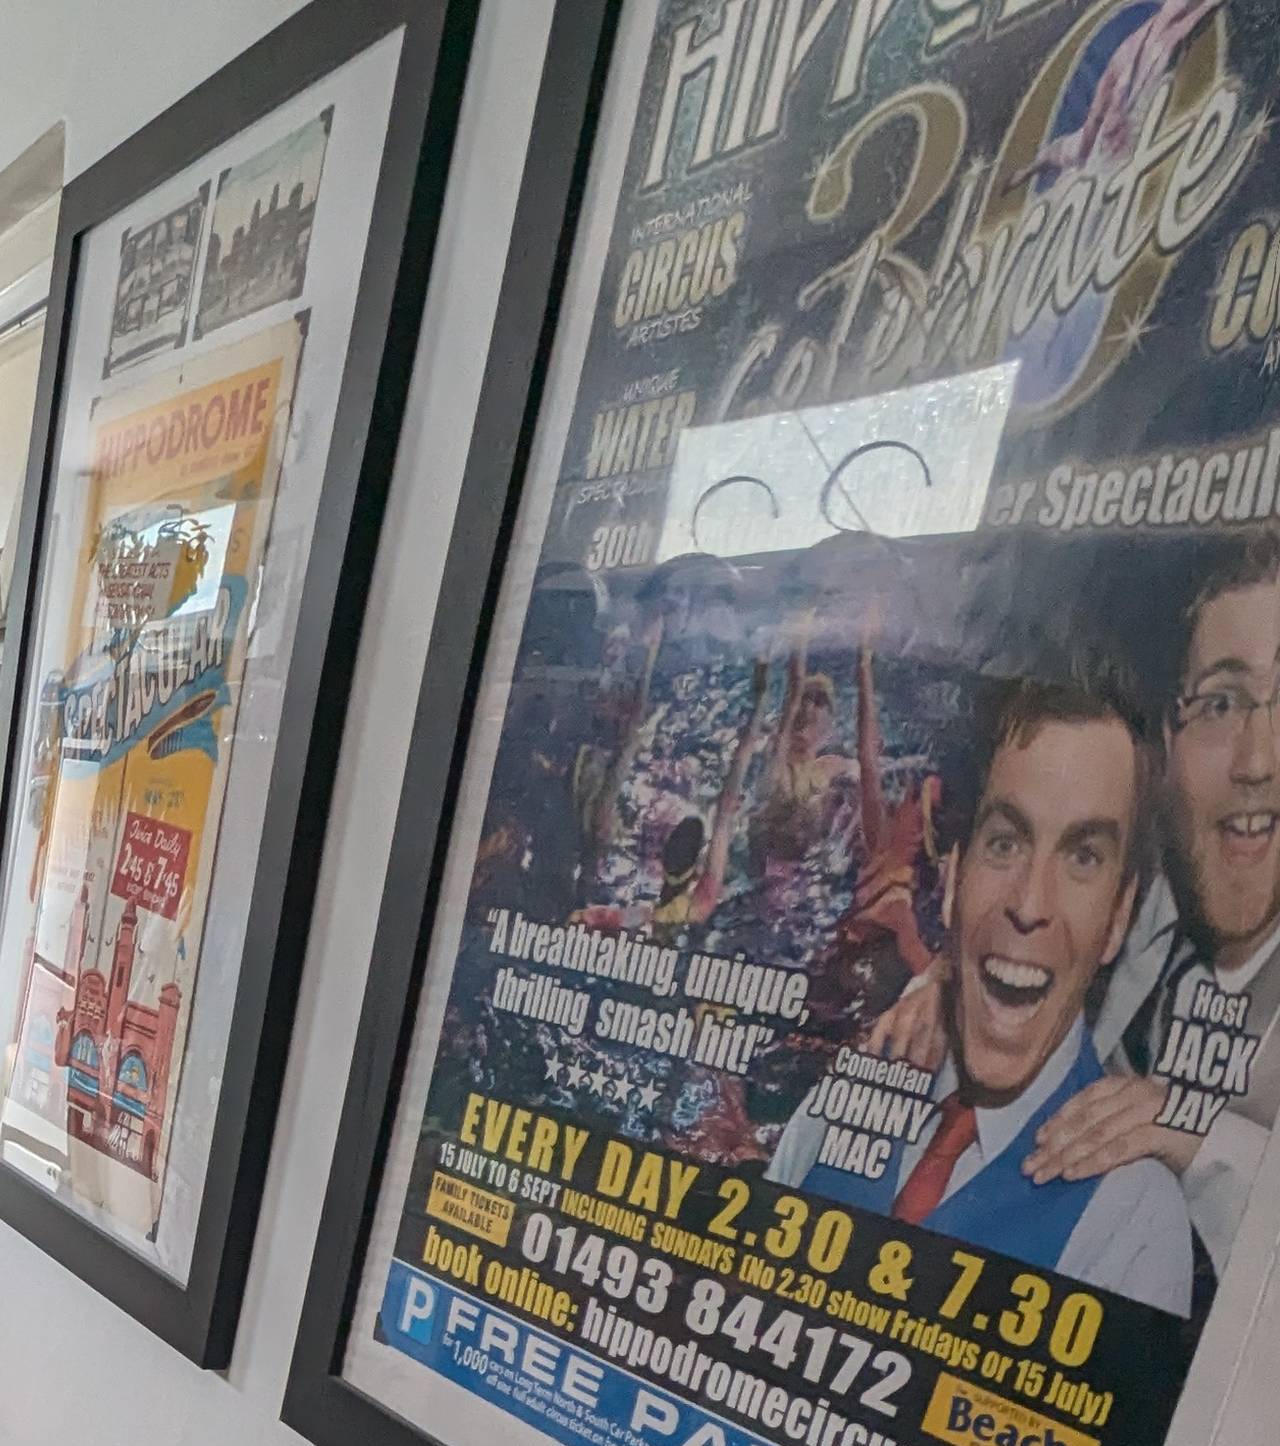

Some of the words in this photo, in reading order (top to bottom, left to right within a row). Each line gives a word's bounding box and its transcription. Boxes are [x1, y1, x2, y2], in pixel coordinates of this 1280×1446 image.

[614, 211, 746, 329] CIRCUS
[96, 377, 272, 482] HIPPODROME
[1040, 427, 1280, 532] Spectacul
[153, 829, 183, 861] Daily
[491, 967, 592, 1036] thrilling
[594, 998, 695, 1058] smash
[507, 911, 679, 998] breathtaking,
[684, 952, 811, 1028] unique,
[1192, 982, 1250, 1029] Host
[834, 1046, 933, 1094] Comedian
[1157, 1020, 1260, 1096] JACK
[808, 1076, 937, 1145] JOHNNY
[818, 1126, 892, 1180] MAC
[1155, 1084, 1231, 1136] JAY
[435, 1176, 469, 1201] FAMILY
[469, 1190, 511, 1221] TICKETS
[442, 1200, 494, 1234] AVAILABLE
[459, 1092, 591, 1182] EVERY
[596, 1139, 701, 1220] DAY
[706, 1177, 856, 1275] 2.30
[867, 1239, 914, 1302] &
[938, 1249, 1105, 1368] 7.30
[422, 1225, 483, 1287] book
[483, 1259, 579, 1333] online:
[439, 1141, 455, 1169] 15
[455, 1150, 487, 1180] JULY
[486, 1158, 508, 1188] TO
[507, 1167, 521, 1193] 6
[520, 1174, 561, 1209] SEPT
[559, 1188, 648, 1244] INCLUDING
[649, 1221, 737, 1276] SUNDAYS
[739, 1251, 776, 1291] (No
[773, 1267, 829, 1308] 2.30
[826, 1289, 895, 1335] show
[889, 1307, 978, 1372] Fridays
[980, 1348, 1014, 1384] or
[1012, 1358, 1048, 1399] 15
[1042, 1371, 1114, 1427] July)
[521, 1212, 674, 1315] 01493
[684, 1279, 913, 1419] 844172
[446, 1295, 605, 1410] FREE
[451, 1339, 490, 1376] 1,000
[552, 1388, 575, 1413] North
[584, 1407, 611, 1434] South
[609, 1421, 627, 1441] Car
